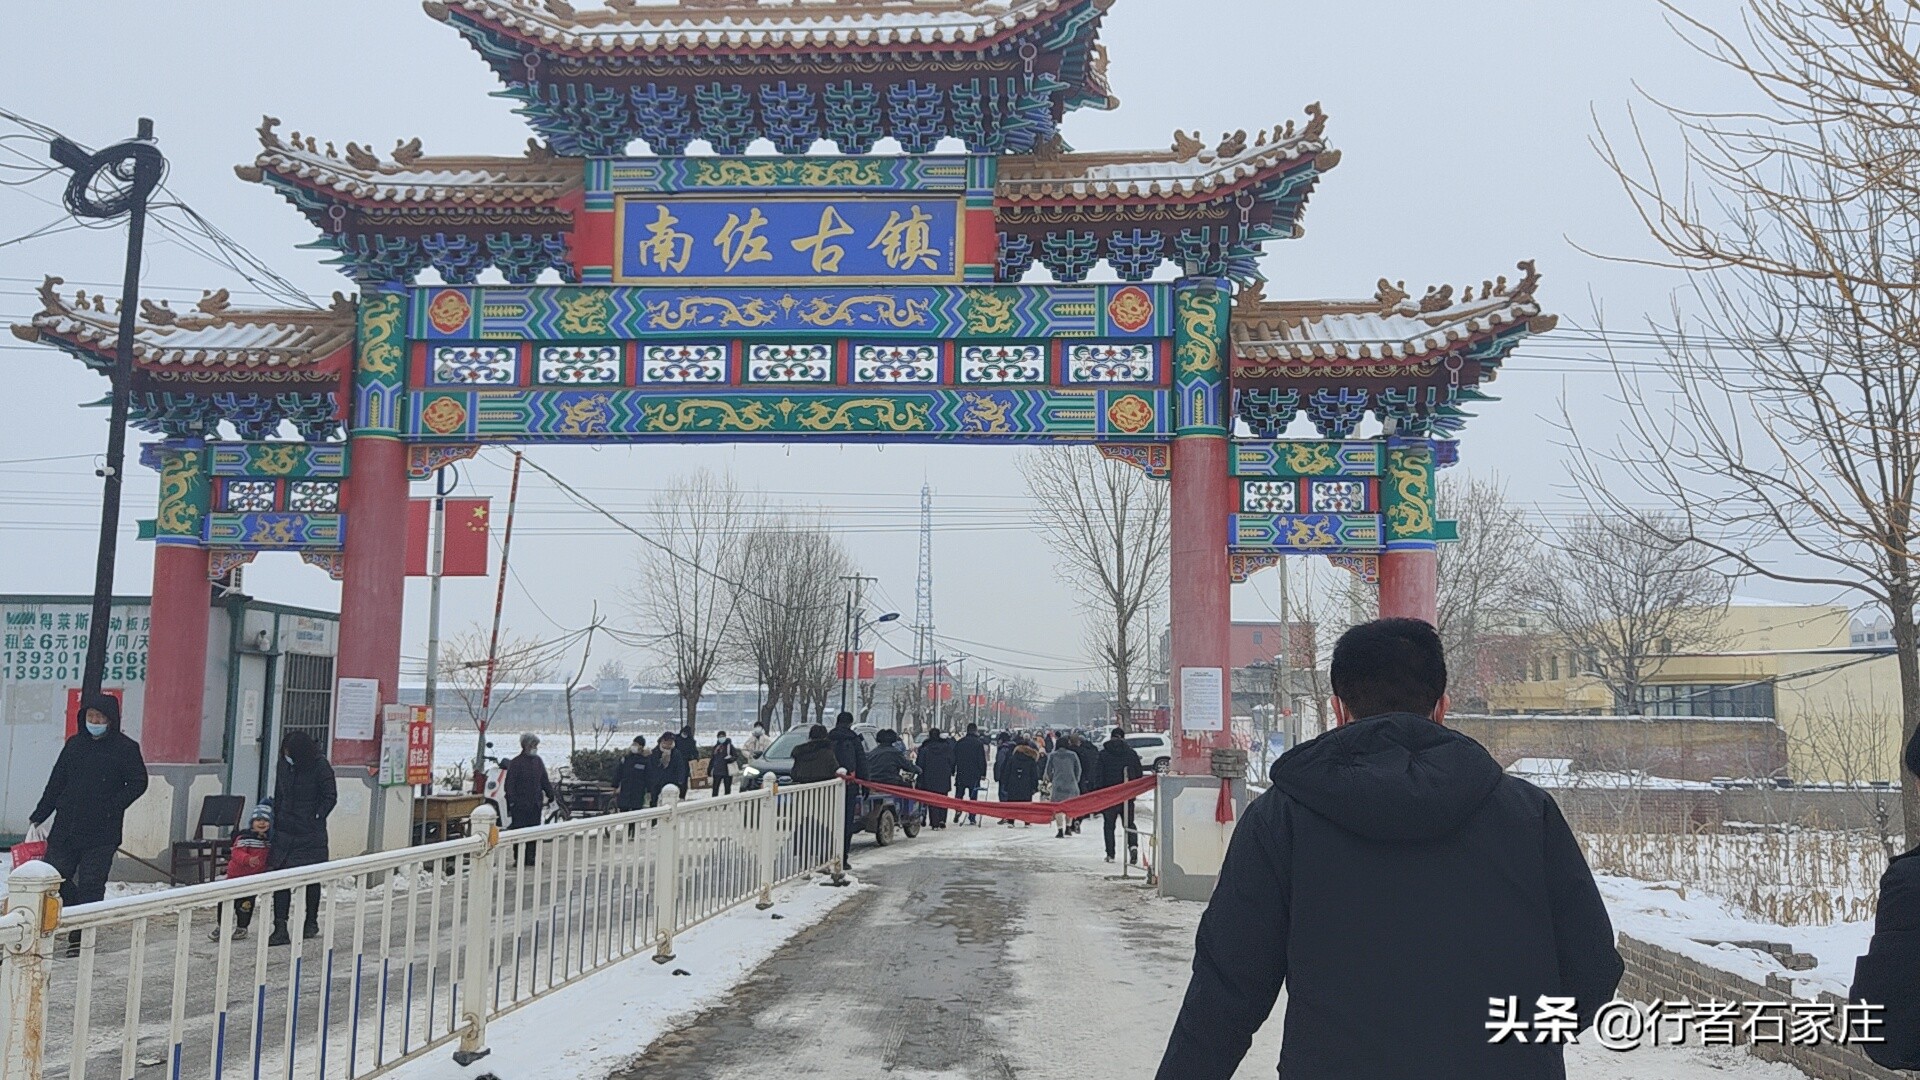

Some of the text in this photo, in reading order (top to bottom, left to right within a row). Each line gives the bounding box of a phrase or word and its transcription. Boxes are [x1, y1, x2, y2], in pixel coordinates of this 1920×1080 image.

[40, 612, 149, 631] 得莱斯动板房
